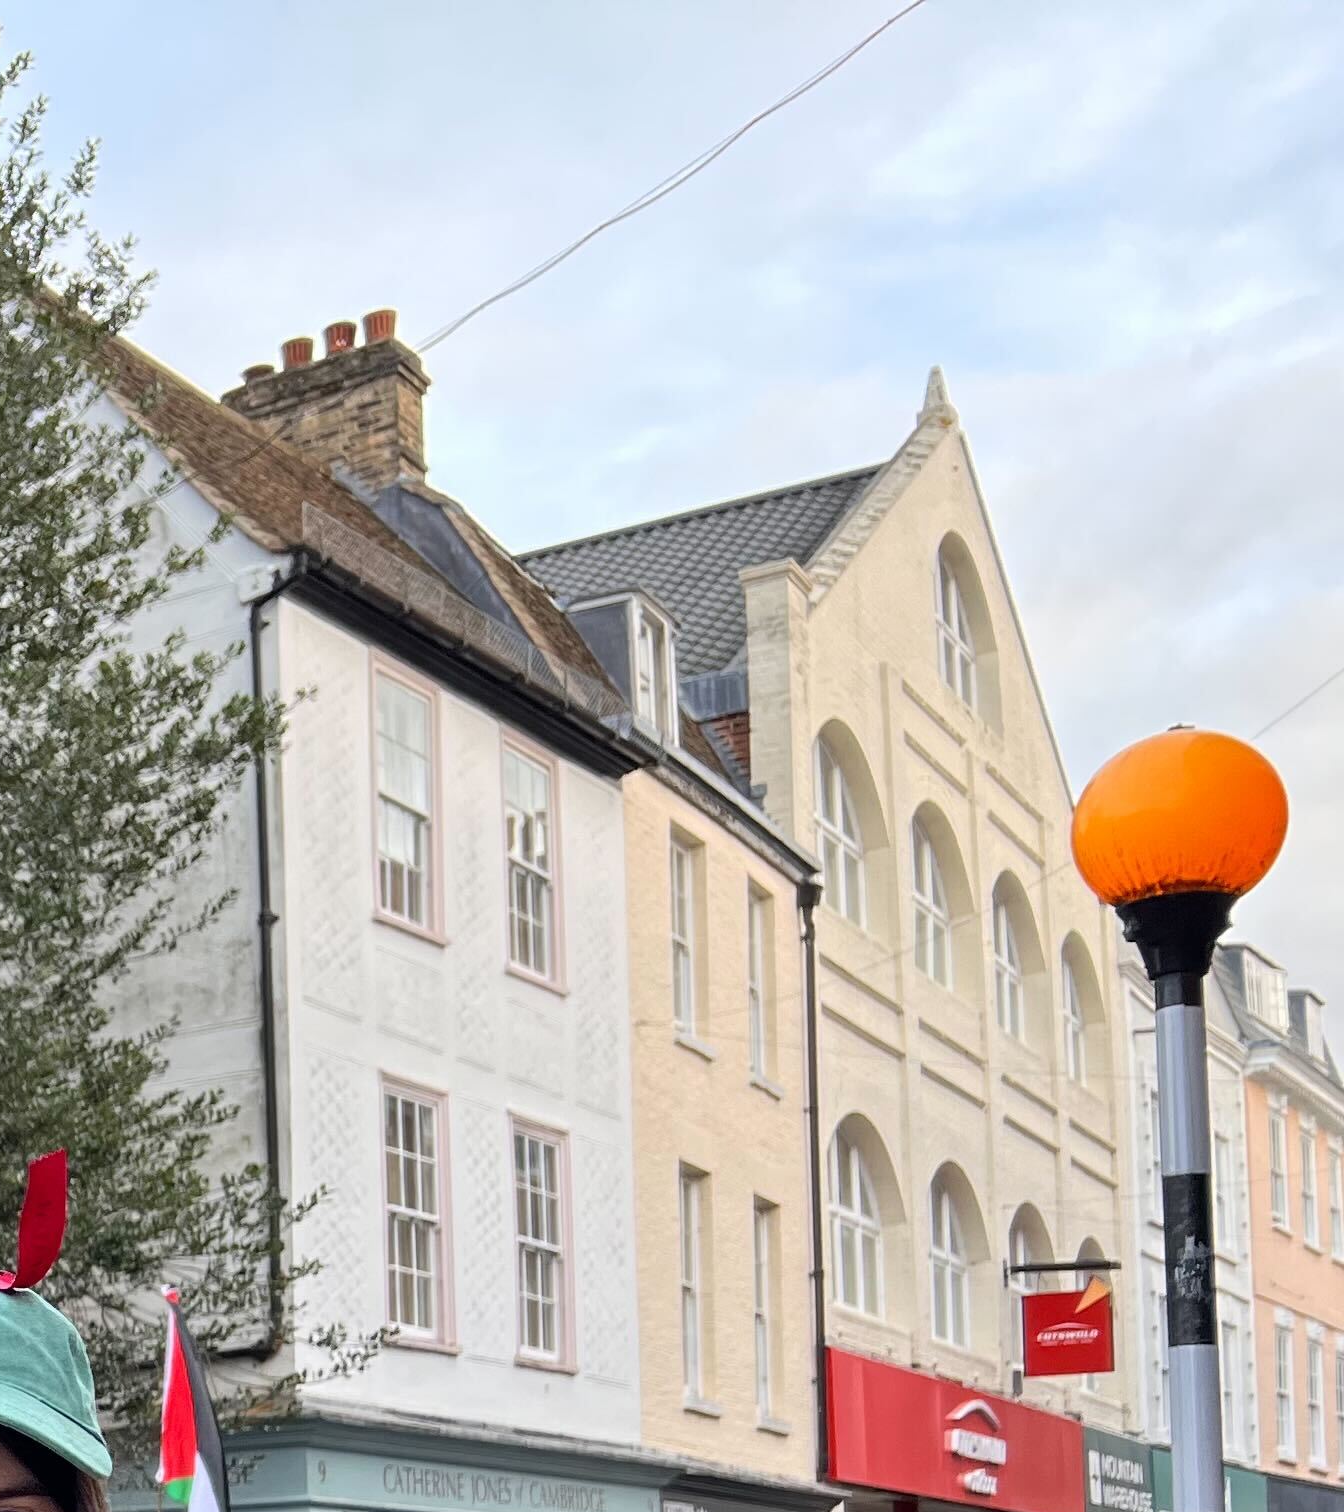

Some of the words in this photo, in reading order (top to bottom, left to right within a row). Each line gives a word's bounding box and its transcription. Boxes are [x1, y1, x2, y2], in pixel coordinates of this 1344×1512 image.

[317, 1459, 327, 1483] 9
[383, 1463, 465, 1500] CATHERINE
[472, 1474, 512, 1505] JONES
[1101, 1453, 1144, 1485] MOUNTAIN
